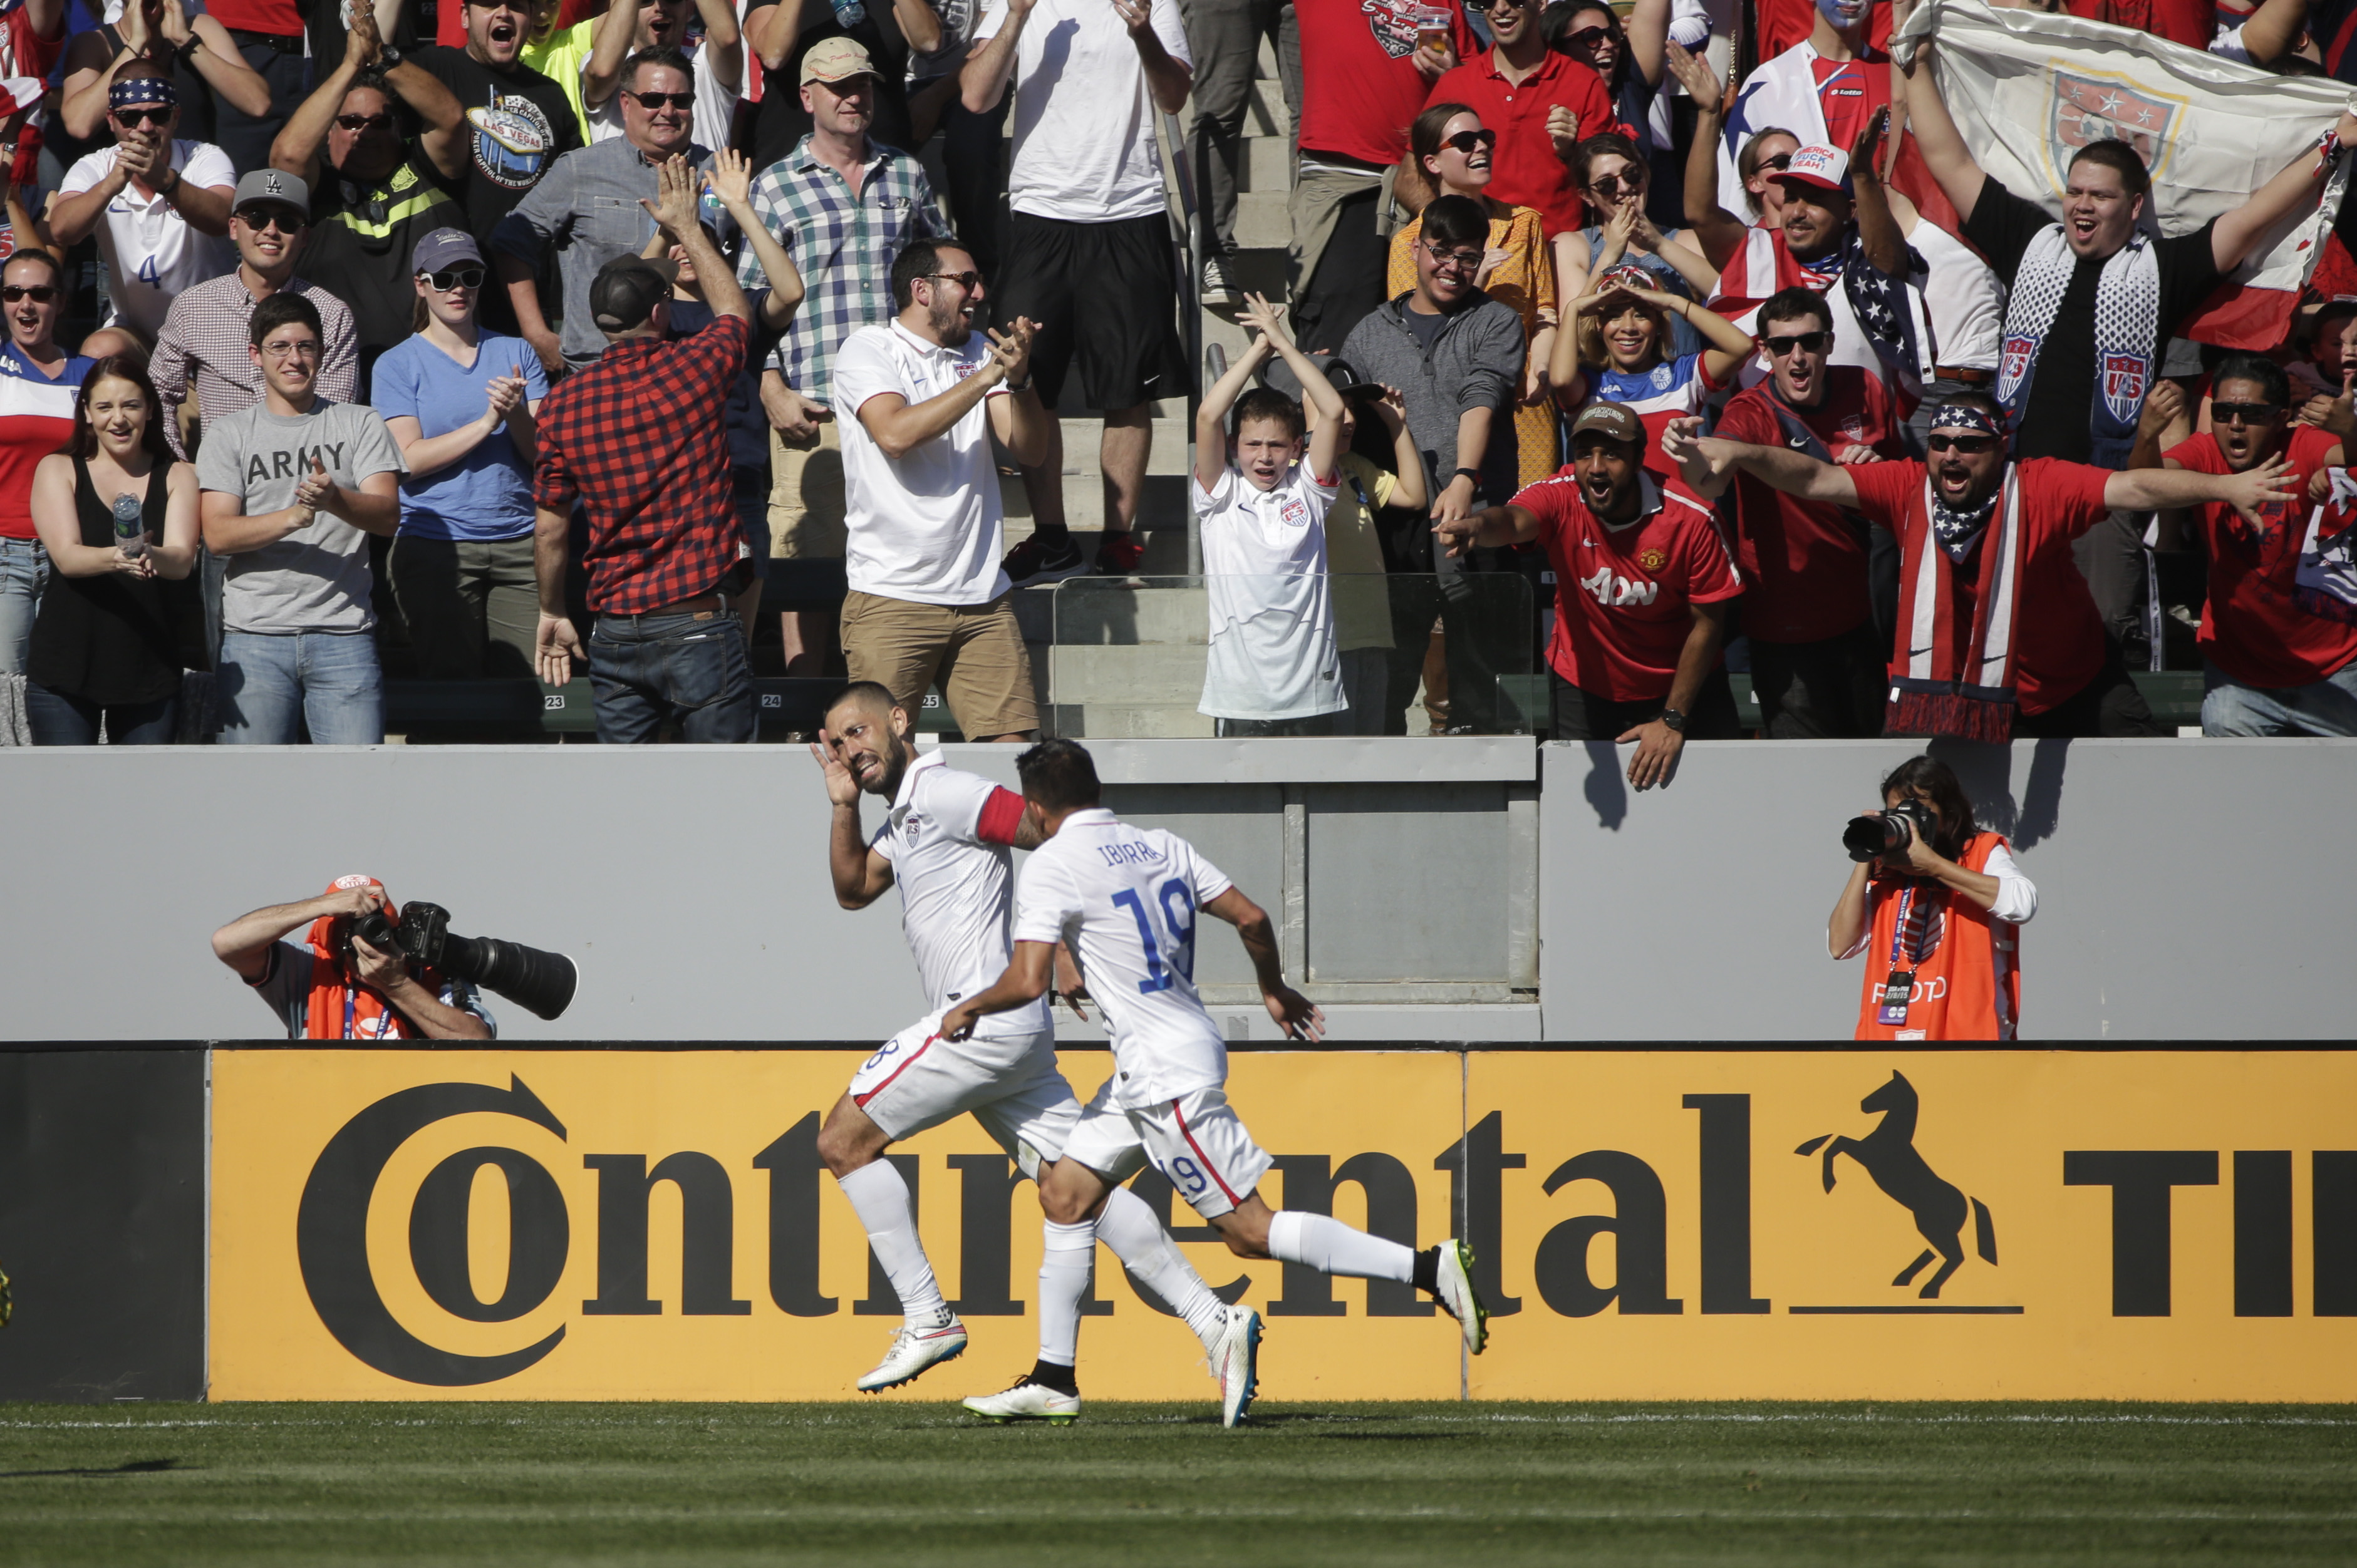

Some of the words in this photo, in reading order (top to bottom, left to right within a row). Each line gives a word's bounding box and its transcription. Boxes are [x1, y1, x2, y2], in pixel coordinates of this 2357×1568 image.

[473, 130, 481, 153] POKER
[484, 118, 504, 135] LAS
[510, 129, 540, 148] VEGAS
[1796, 146, 1835, 160] AMERICA
[1796, 153, 1827, 163] FUCK
[475, 153, 498, 179] CAPITOL
[266, 173, 282, 195] LA
[138, 254, 161, 289] 4
[1, 355, 23, 374] USA
[1599, 384, 1622, 394] USA
[2108, 373, 2143, 399] US
[247, 441, 345, 485] ARMY
[1580, 567, 1658, 606] AON
[546, 696, 562, 708] 23
[764, 696, 780, 706] 24
[923, 696, 937, 706] 25
[1111, 877, 1196, 994] 19
[1872, 976, 1947, 1004] POTO
[866, 1039, 899, 1070] 8
